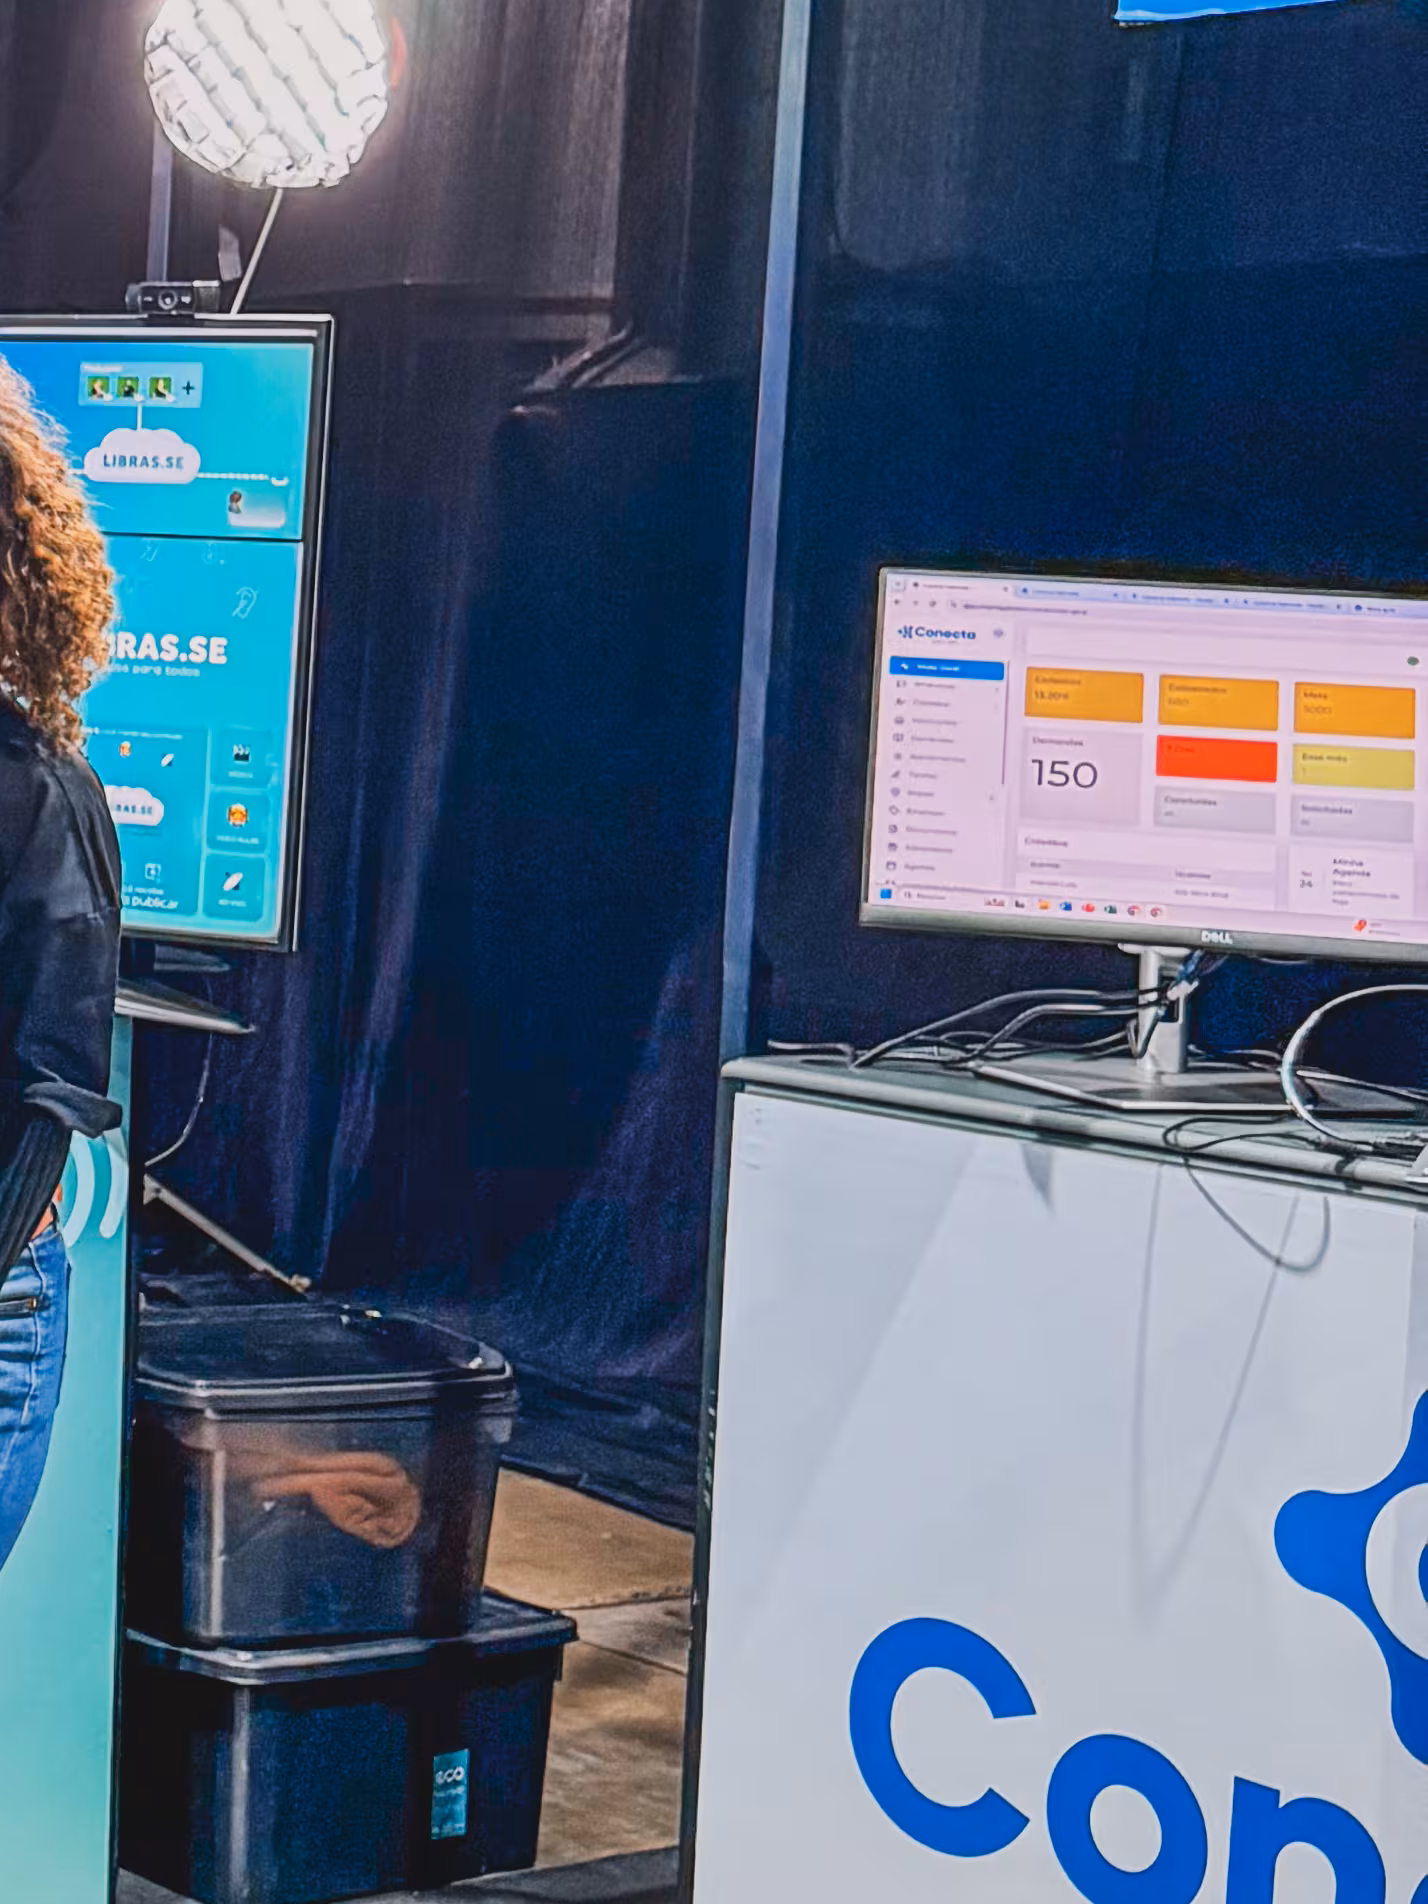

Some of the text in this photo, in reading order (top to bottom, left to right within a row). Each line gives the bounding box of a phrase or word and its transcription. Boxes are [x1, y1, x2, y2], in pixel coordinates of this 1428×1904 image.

[103, 454, 185, 470] LIBRAS.SE
[915, 626, 977, 640] Conecta
[1031, 758, 1099, 789] 150
[1201, 930, 1233, 945] DELL
